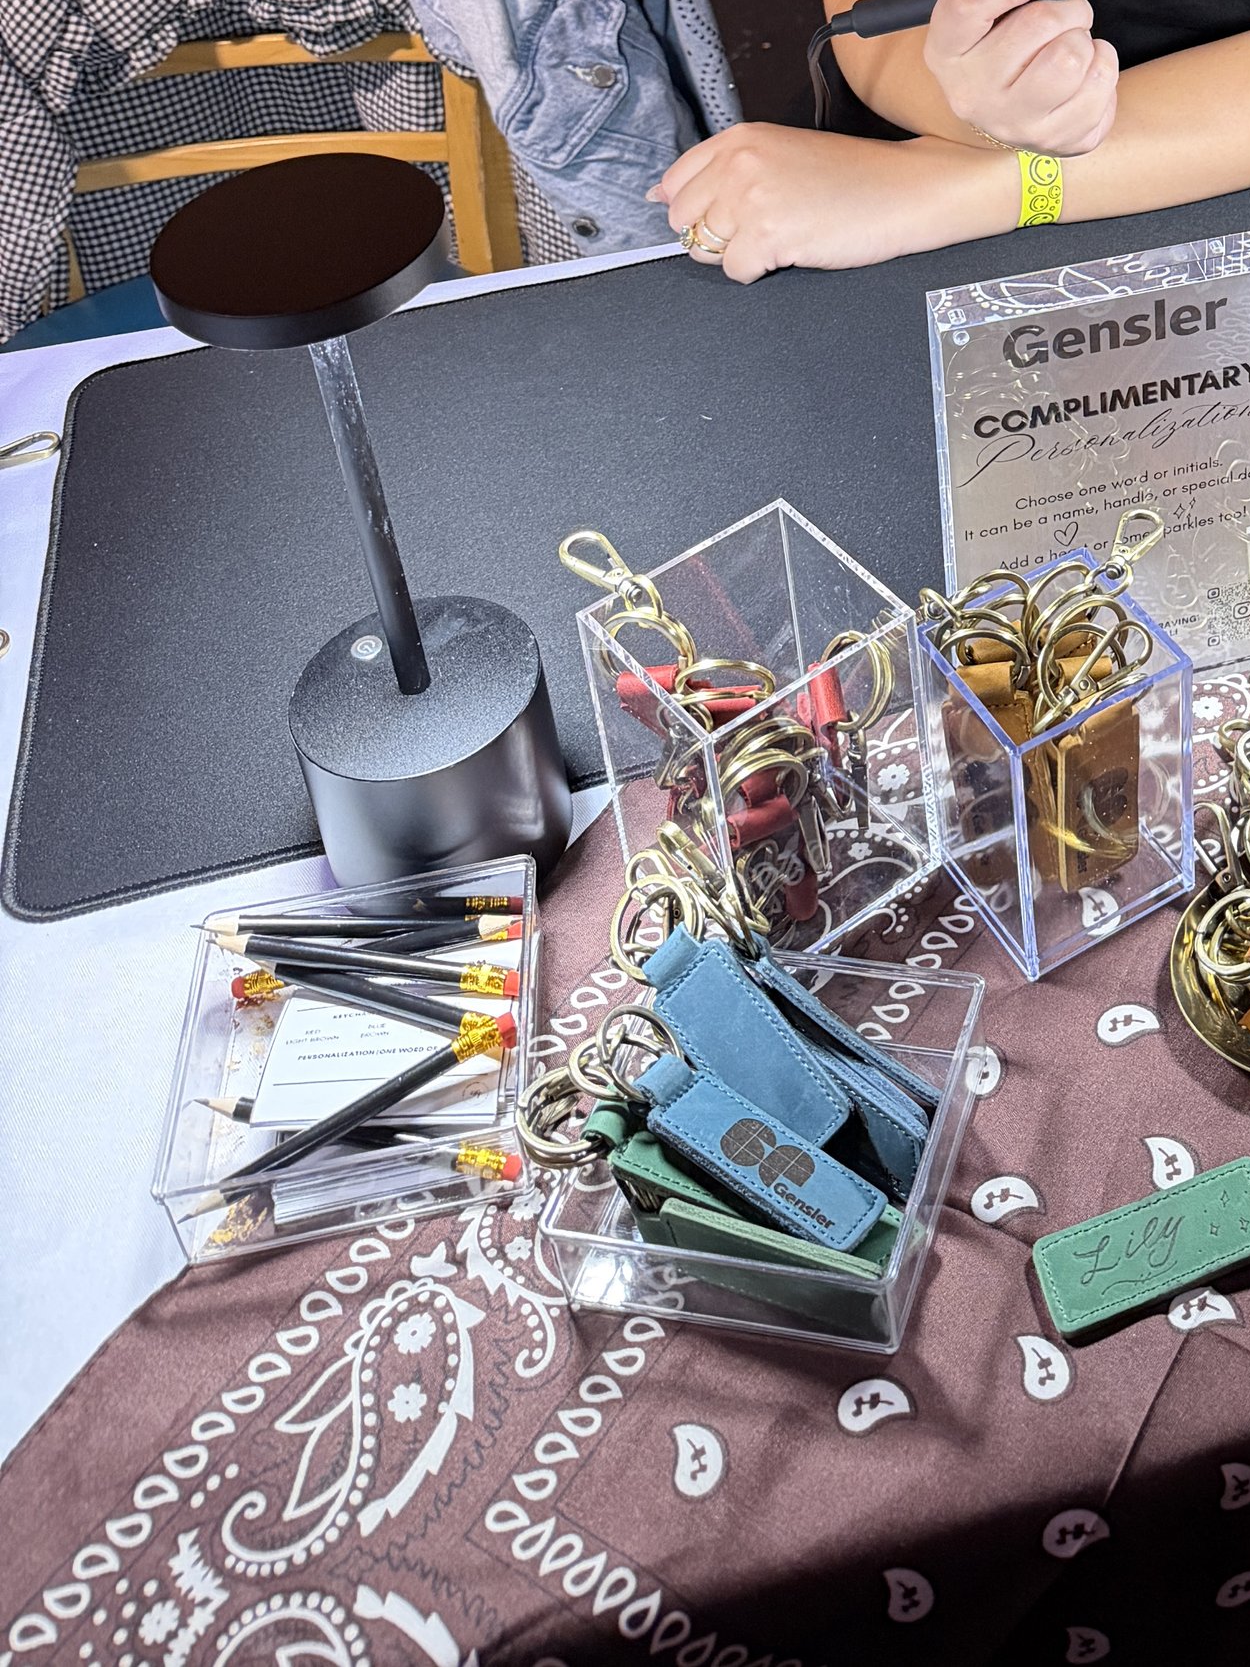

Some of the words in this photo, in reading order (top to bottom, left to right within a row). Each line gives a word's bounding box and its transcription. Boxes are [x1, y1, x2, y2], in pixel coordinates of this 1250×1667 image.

[1003, 297, 1228, 369] Gensler
[965, 530, 975, 542] It
[980, 525, 1008, 540] can
[1013, 518, 1033, 531] be
[1038, 516, 1048, 525] a
[1053, 505, 1098, 522] name,
[1104, 490, 1158, 511] handle,
[1163, 486, 1178, 498] or
[1182, 472, 1233, 495] special
[1016, 490, 1074, 511] Choose
[1079, 484, 1107, 497] one
[1111, 470, 1149, 490] word
[1154, 470, 1169, 481] or
[1173, 457, 1224, 476] initials.
[1000, 554, 1029, 571] Add
[1034, 556, 1044, 565] a
[1093, 540, 1109, 551] or
[1114, 531, 1150, 546] ome
[1163, 516, 1214, 538] parkles
[1218, 505, 1247, 523] too!
[773, 1182, 836, 1230] Gensler
[1073, 1215, 1187, 1286] Lily
